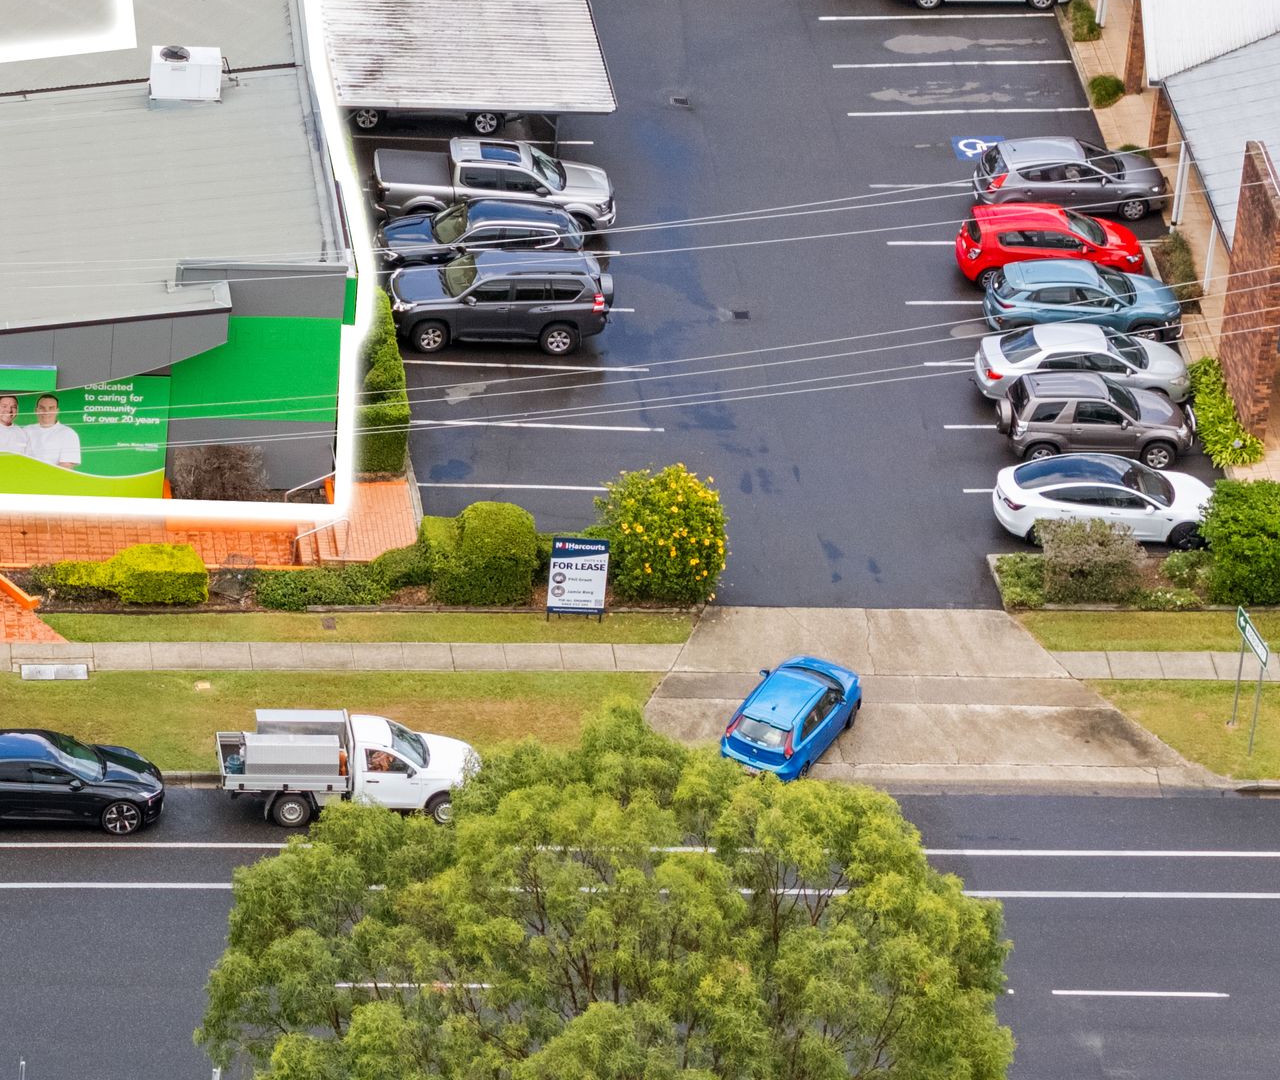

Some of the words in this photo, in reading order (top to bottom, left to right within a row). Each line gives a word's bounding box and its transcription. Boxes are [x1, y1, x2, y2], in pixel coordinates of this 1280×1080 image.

[84, 393, 95, 401] to
[97, 393, 127, 404] caring
[129, 393, 144, 402] for
[83, 404, 137, 415] community
[82, 413, 97, 423] for
[121, 415, 134, 424] 20
[135, 416, 160, 426] years
[569, 542, 605, 551] Harcourts
[552, 562, 573, 570] FOR
[575, 563, 606, 571] LEASE
